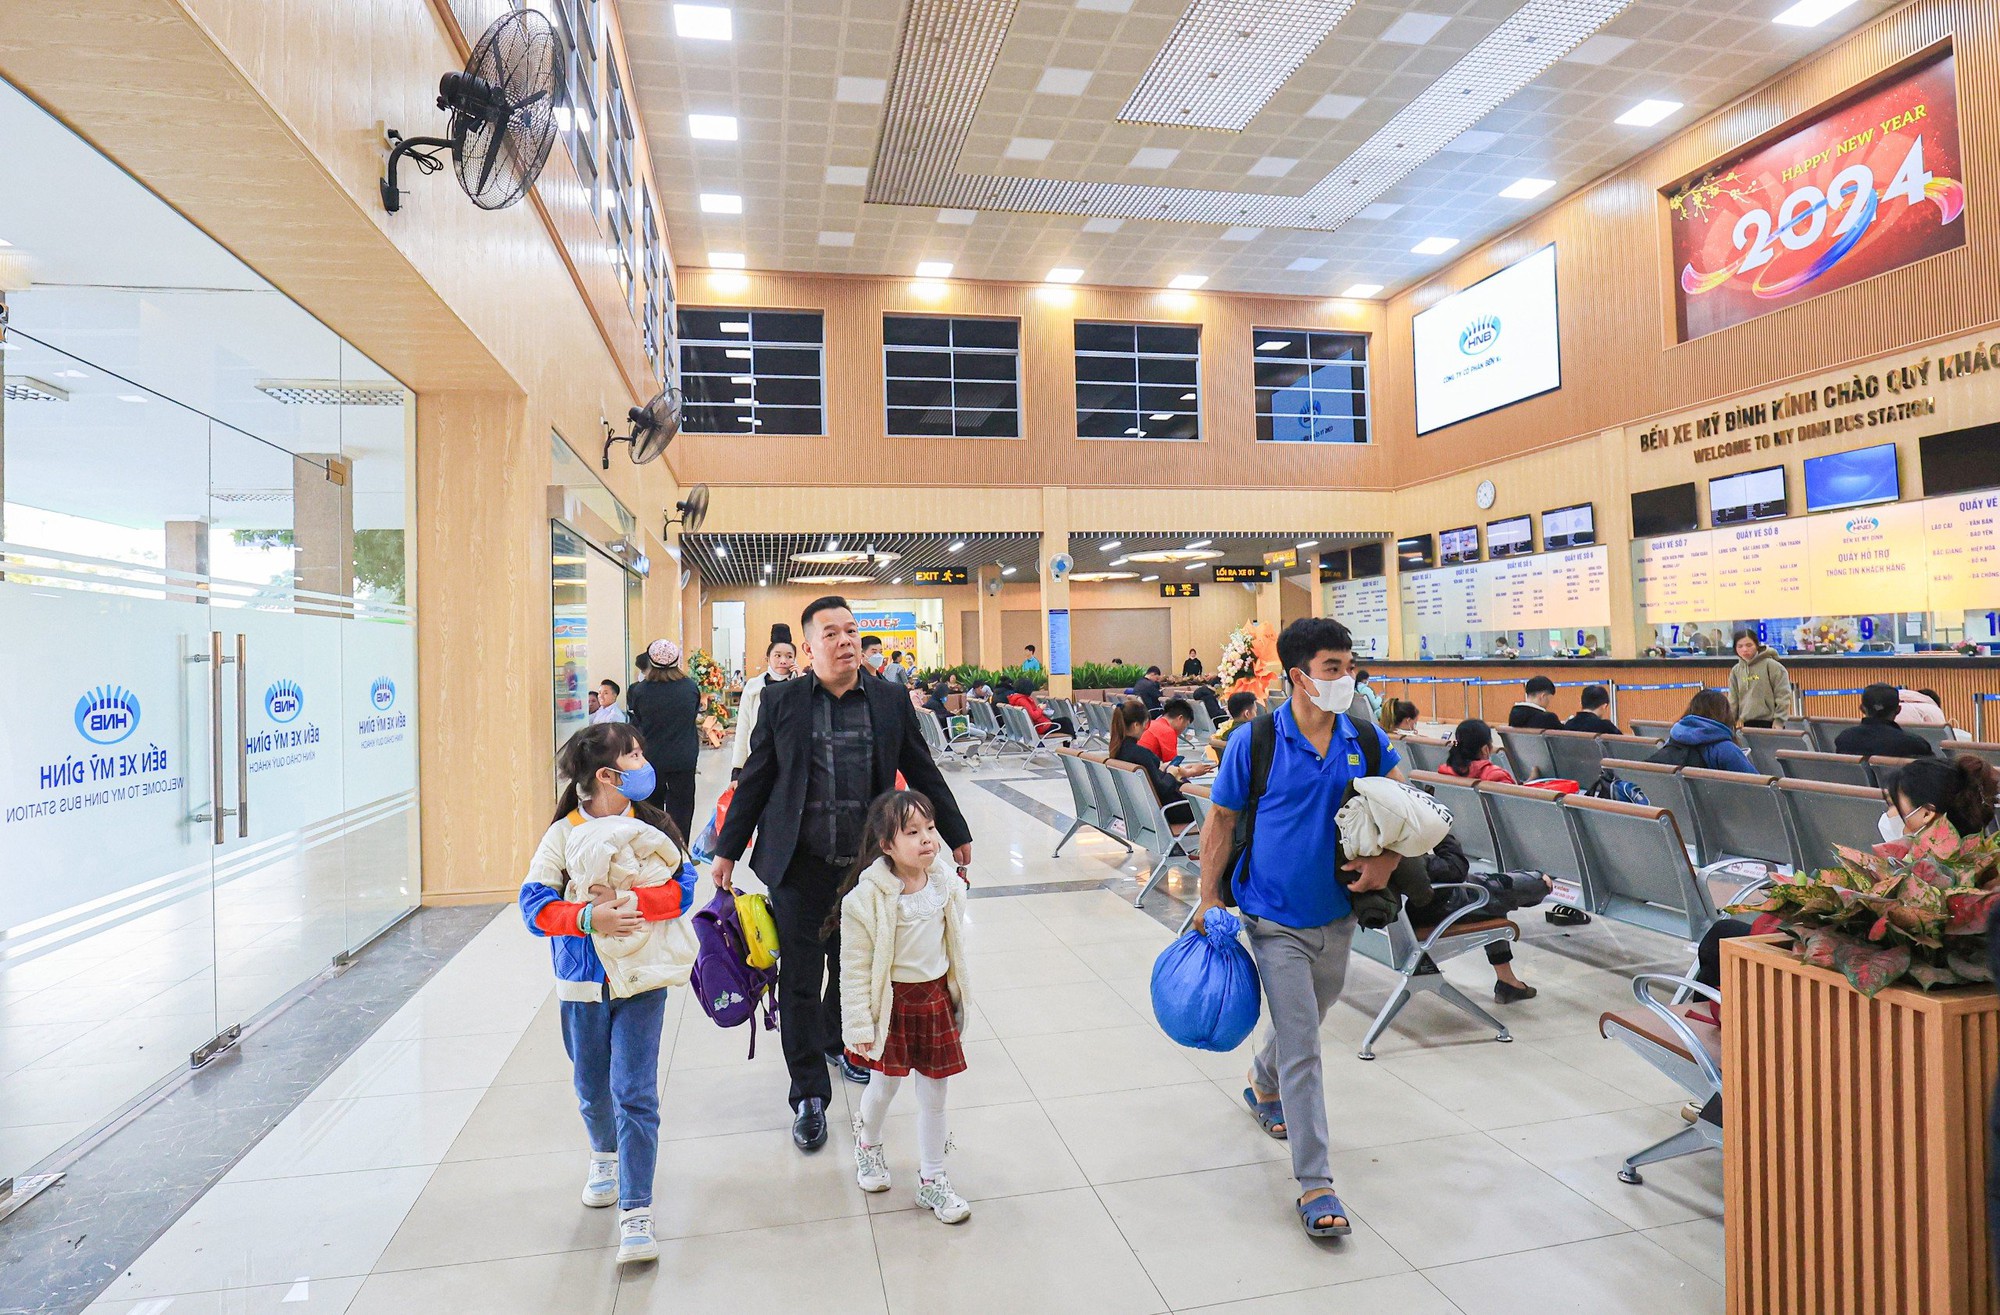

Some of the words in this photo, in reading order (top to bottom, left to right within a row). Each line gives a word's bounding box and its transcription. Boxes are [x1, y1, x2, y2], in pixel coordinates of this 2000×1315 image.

[1781, 149, 1832, 184] HAPPY
[1836, 128, 1875, 158] NEW
[1880, 104, 1927, 136] YEAR
[1732, 134, 1933, 275] 2024
[1468, 331, 1492, 348] HNB
[1640, 423, 1668, 452] BẾN
[1673, 425, 1692, 445] XE
[1697, 412, 1720, 440] MỸ
[1725, 403, 1767, 432] ĐÌNH
[1772, 390, 1817, 421] KÍNH
[1823, 375, 1879, 409] CHÀO
[1886, 356, 1931, 395] QUÝ
[1694, 438, 1751, 464] WELCOME
[1754, 434, 1771, 451] TO
[1774, 428, 1794, 447] MY
[1797, 420, 1832, 442] DINH
[1834, 414, 1865, 434] BUS
[1867, 396, 1935, 427] STATION
[916, 572, 939, 580] EXIT
[1216, 567, 1227, 576] LỐI
[857, 617, 900, 629] OVIỆT
[1860, 616, 1873, 640] 9
[1985, 611, 2000, 636] 1
[1518, 632, 1524, 648] 5
[1577, 630, 1584, 646] 6
[1671, 625, 1679, 644] 7
[1758, 622, 1768, 642] 8
[1372, 638, 1376, 650] 2
[1422, 636, 1426, 650] 3
[1466, 634, 1472, 648] 4
